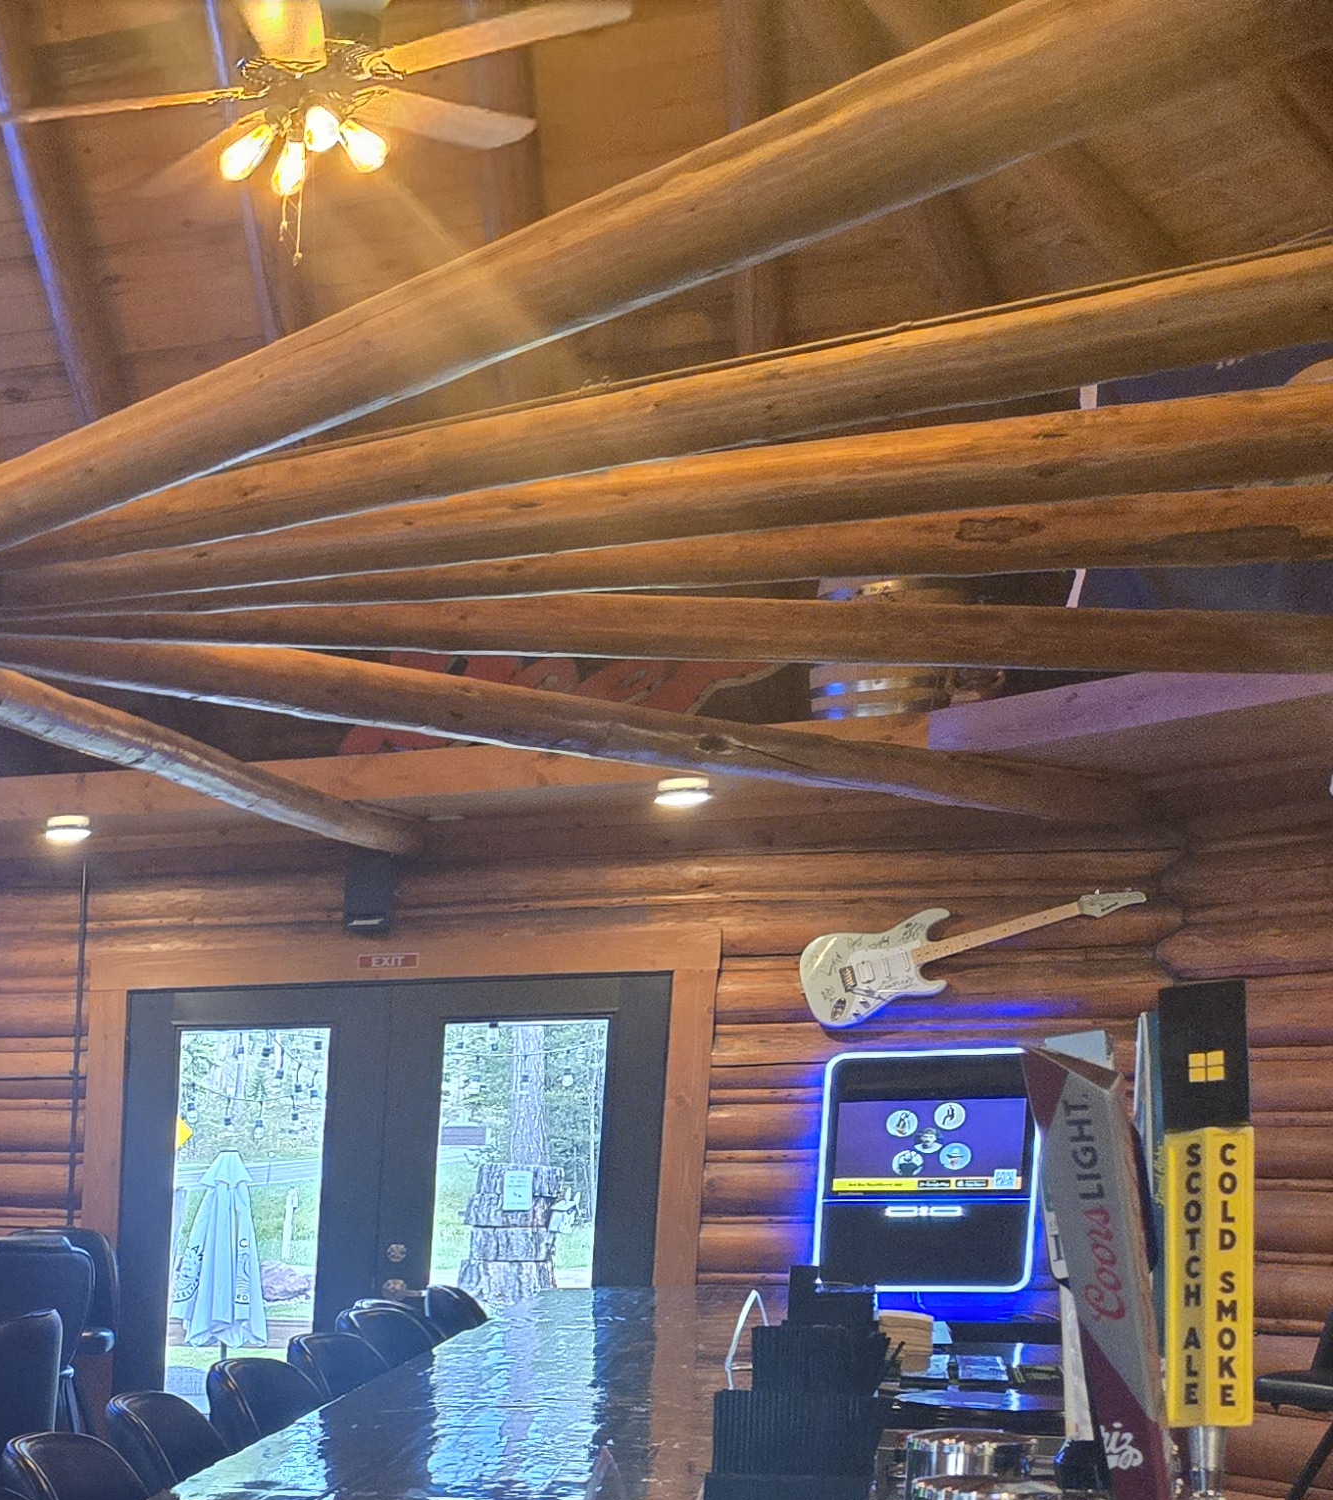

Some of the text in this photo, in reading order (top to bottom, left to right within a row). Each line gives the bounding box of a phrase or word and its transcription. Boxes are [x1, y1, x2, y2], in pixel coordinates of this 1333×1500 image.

[371, 956, 405, 967] EXIT
[1063, 1099, 1126, 1321] Coors LIGHT
[1183, 1143, 1202, 1406] SCOTCH ALE
[1216, 1143, 1238, 1407] COLD SMOKE
